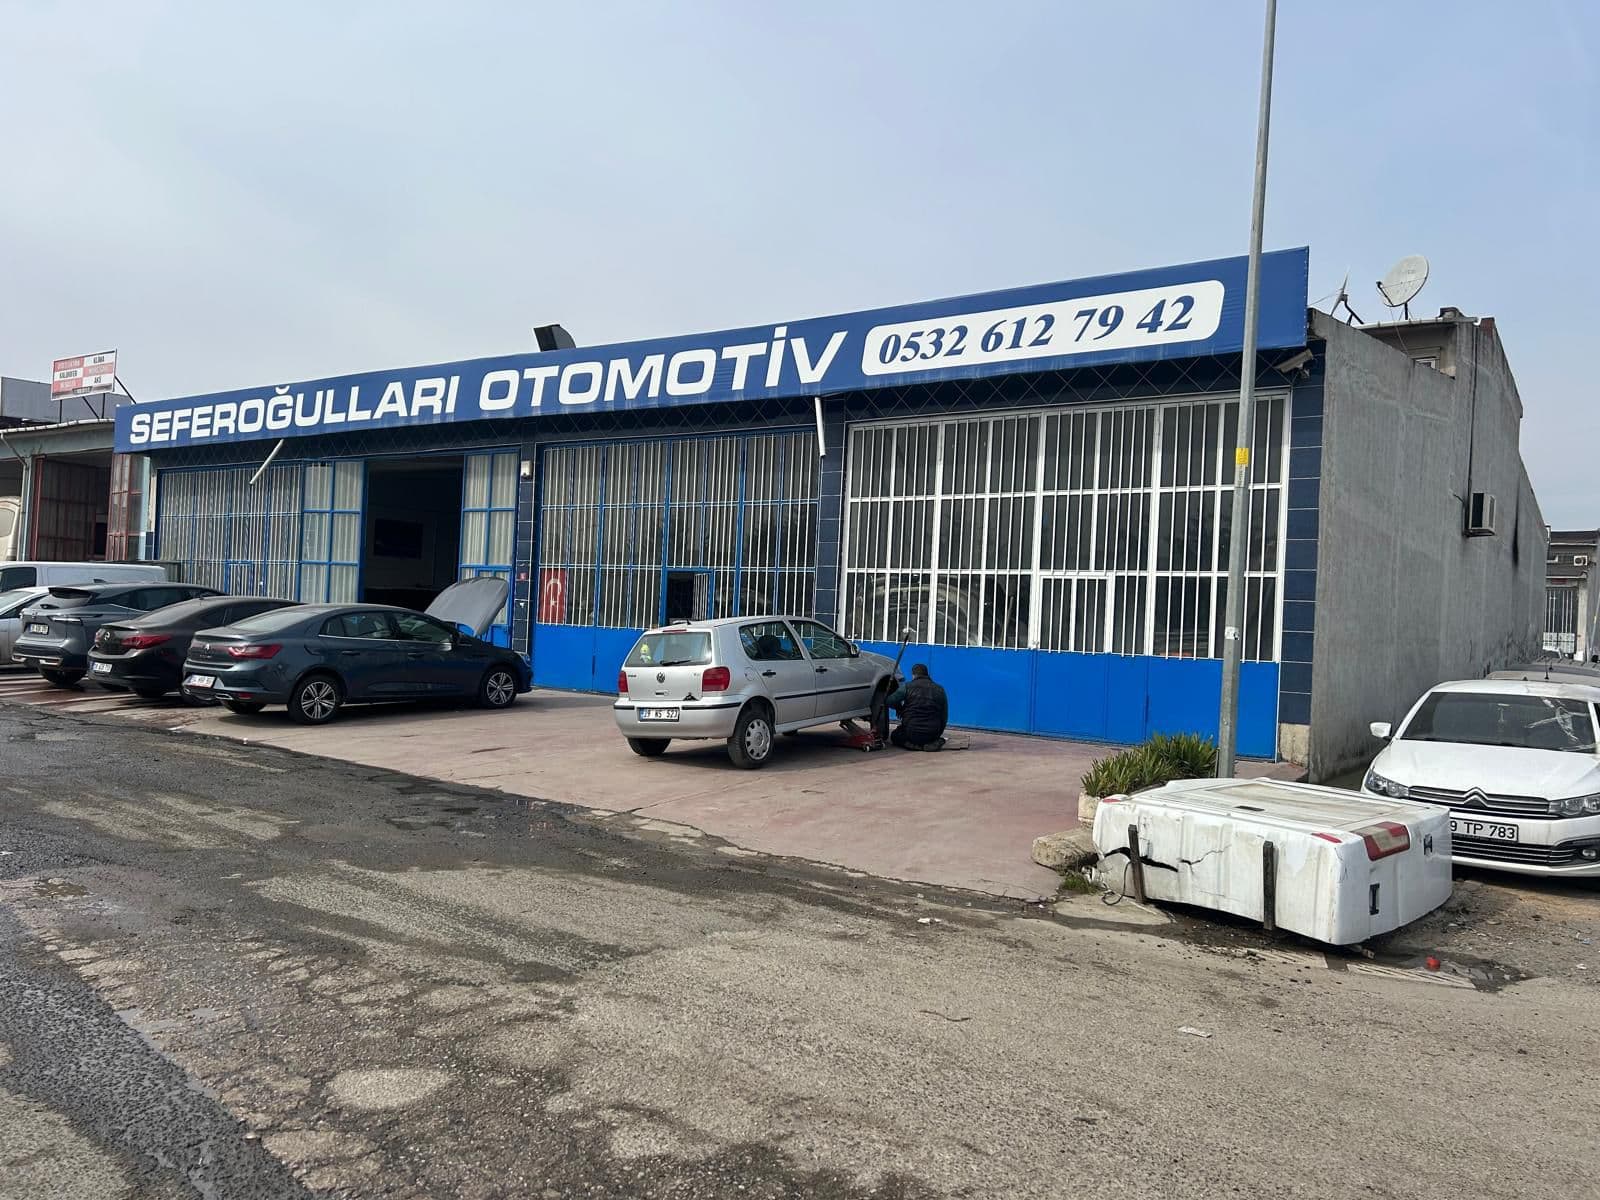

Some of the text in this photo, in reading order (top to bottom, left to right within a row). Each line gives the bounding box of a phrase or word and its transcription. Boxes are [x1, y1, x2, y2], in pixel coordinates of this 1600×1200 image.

[878, 295, 1195, 365] 0532 612 79 42
[129, 325, 848, 444] SEFEROĞULLARI OTOMOTİV
[1450, 820, 1516, 840] 9 TP 783
